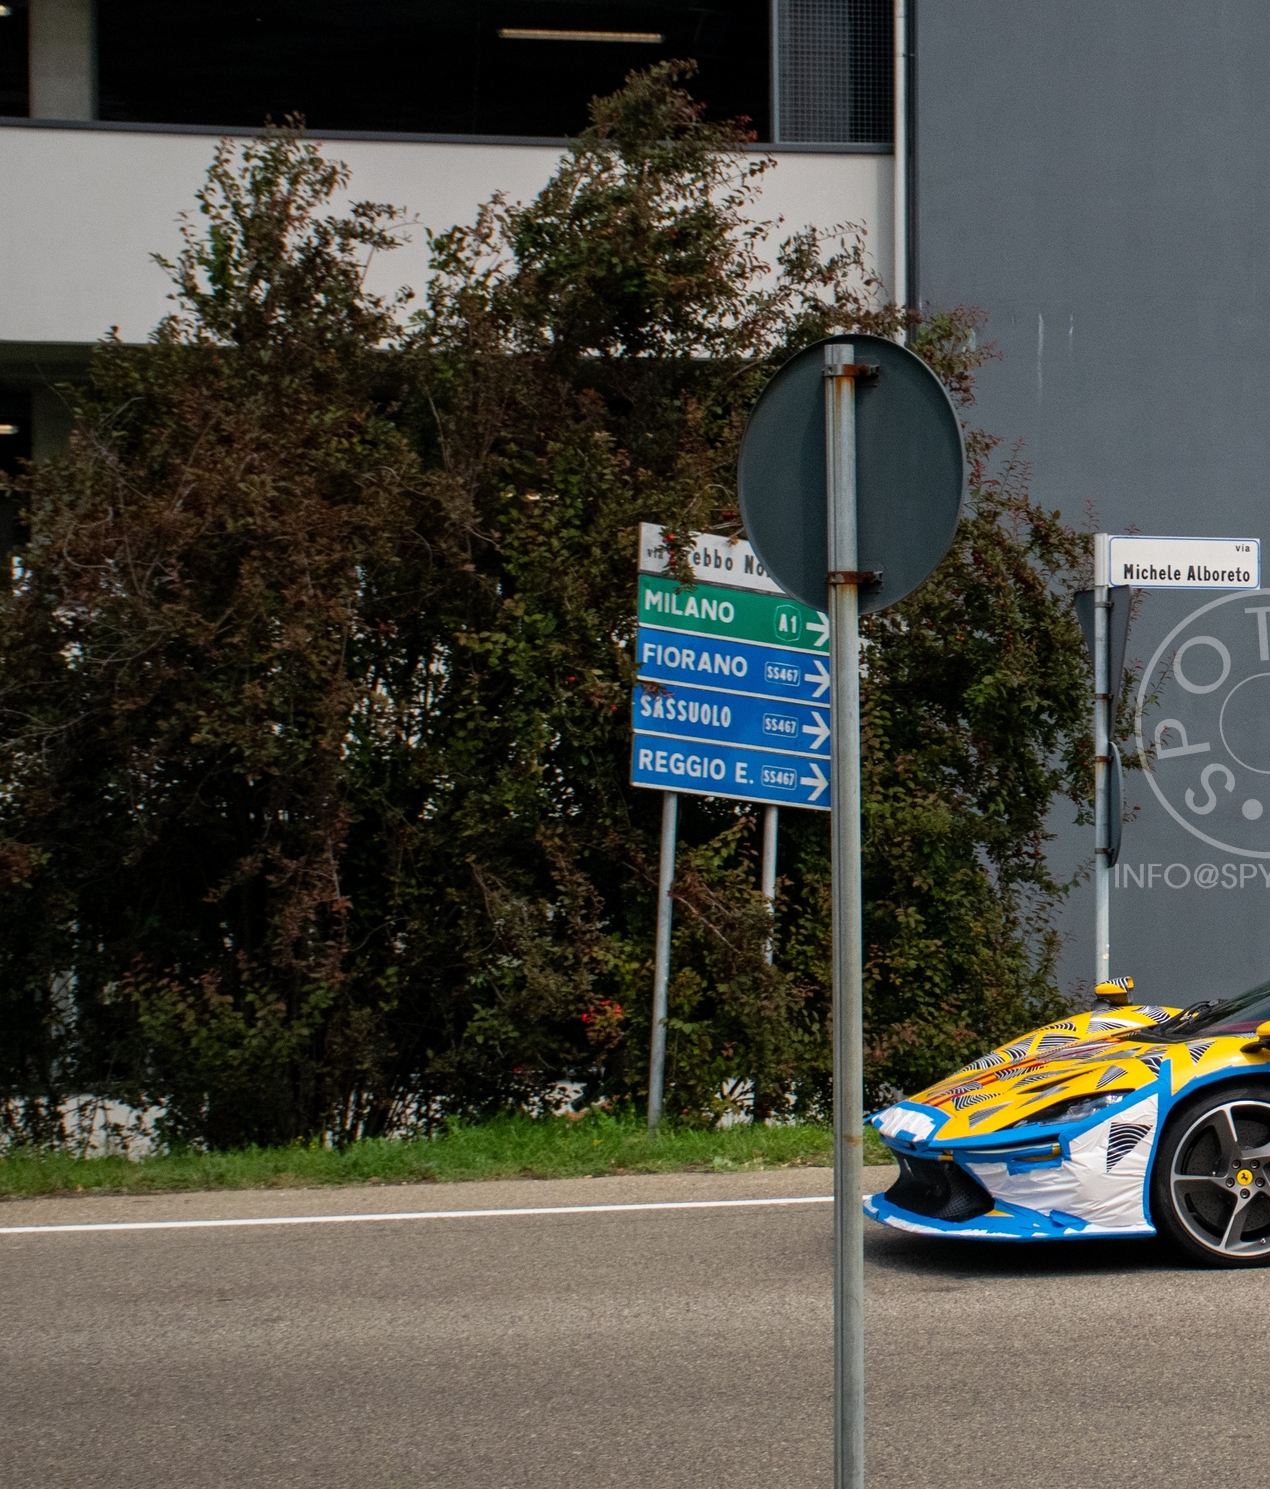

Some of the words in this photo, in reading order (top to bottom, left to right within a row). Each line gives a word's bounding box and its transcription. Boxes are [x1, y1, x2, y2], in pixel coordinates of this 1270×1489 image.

[744, 554, 772, 577] No
[1235, 544, 1250, 552] via
[1123, 564, 1181, 580] Michele
[1187, 565, 1250, 582] Alboreto
[644, 589, 735, 623] MILANO
[778, 613, 797, 634] A1
[642, 642, 748, 677] FIORANO
[767, 665, 798, 683] SS467
[640, 695, 731, 728] SASSUOLO
[764, 717, 797, 734] SS467
[638, 748, 726, 780] REGGIO
[735, 761, 754, 785] E.
[763, 769, 795, 787] SS467
